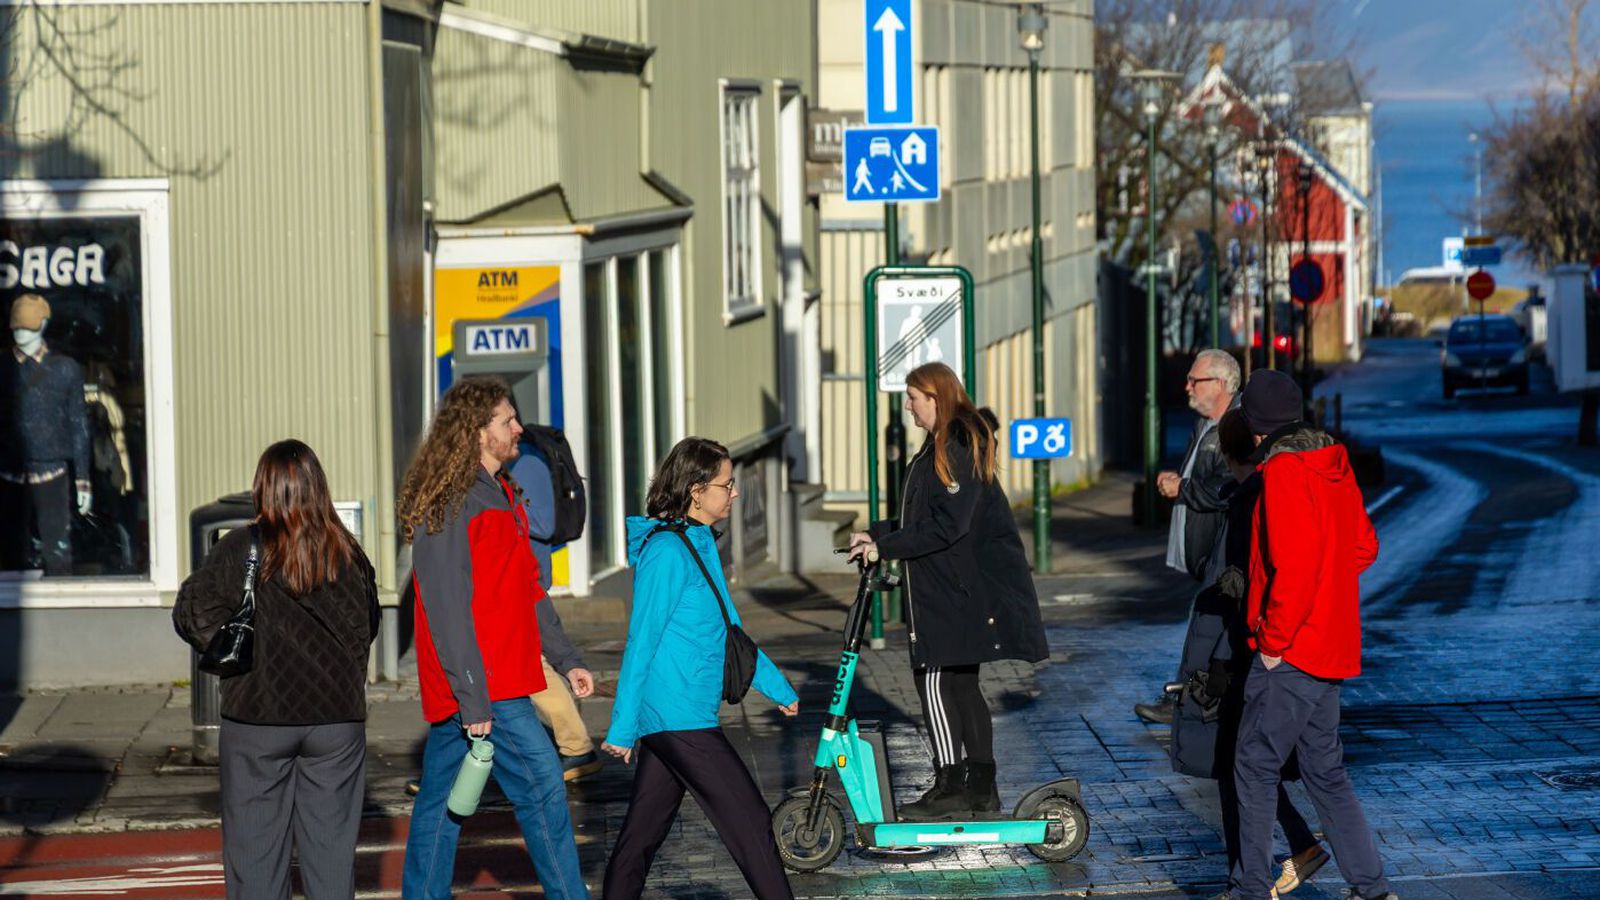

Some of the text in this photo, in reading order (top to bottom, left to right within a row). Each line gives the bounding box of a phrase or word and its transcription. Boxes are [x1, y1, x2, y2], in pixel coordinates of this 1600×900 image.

[478, 271, 518, 288] ATM
[473, 327, 529, 350] ATM
[1016, 424, 1039, 455] P
